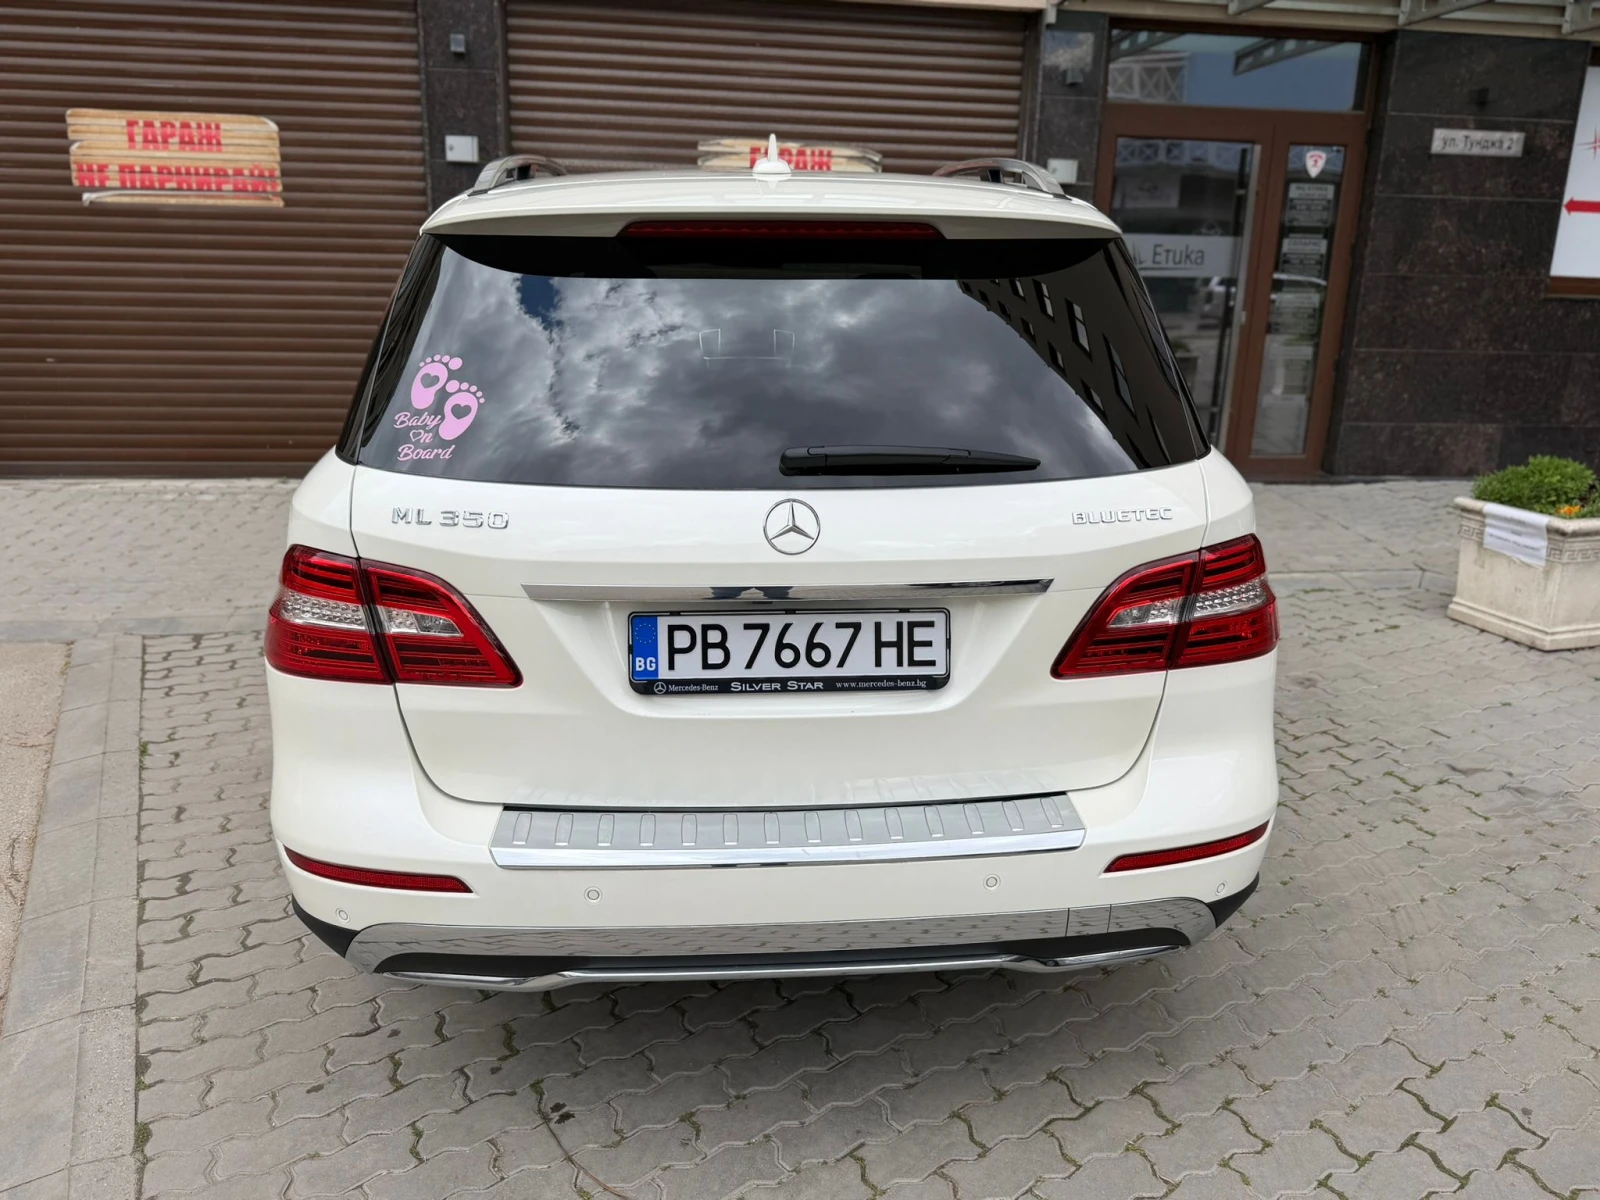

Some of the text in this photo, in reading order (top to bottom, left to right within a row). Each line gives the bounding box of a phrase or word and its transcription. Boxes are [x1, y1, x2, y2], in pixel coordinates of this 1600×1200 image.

[126, 119, 223, 153] ГАРАЖ
[1441, 136, 1458, 149] ул.
[76, 163, 110, 188] НЕ
[394, 412, 441, 430] Baby
[397, 444, 456, 461] Board
[391, 507, 510, 529] ML 350
[1072, 506, 1173, 525] BLUETEC
[668, 621, 937, 671] PB 7667 HE
[635, 657, 656, 671] BG
[668, 679, 927, 692] Mercedes-Benz SILVER STAR www.mercedes-benz.bg
